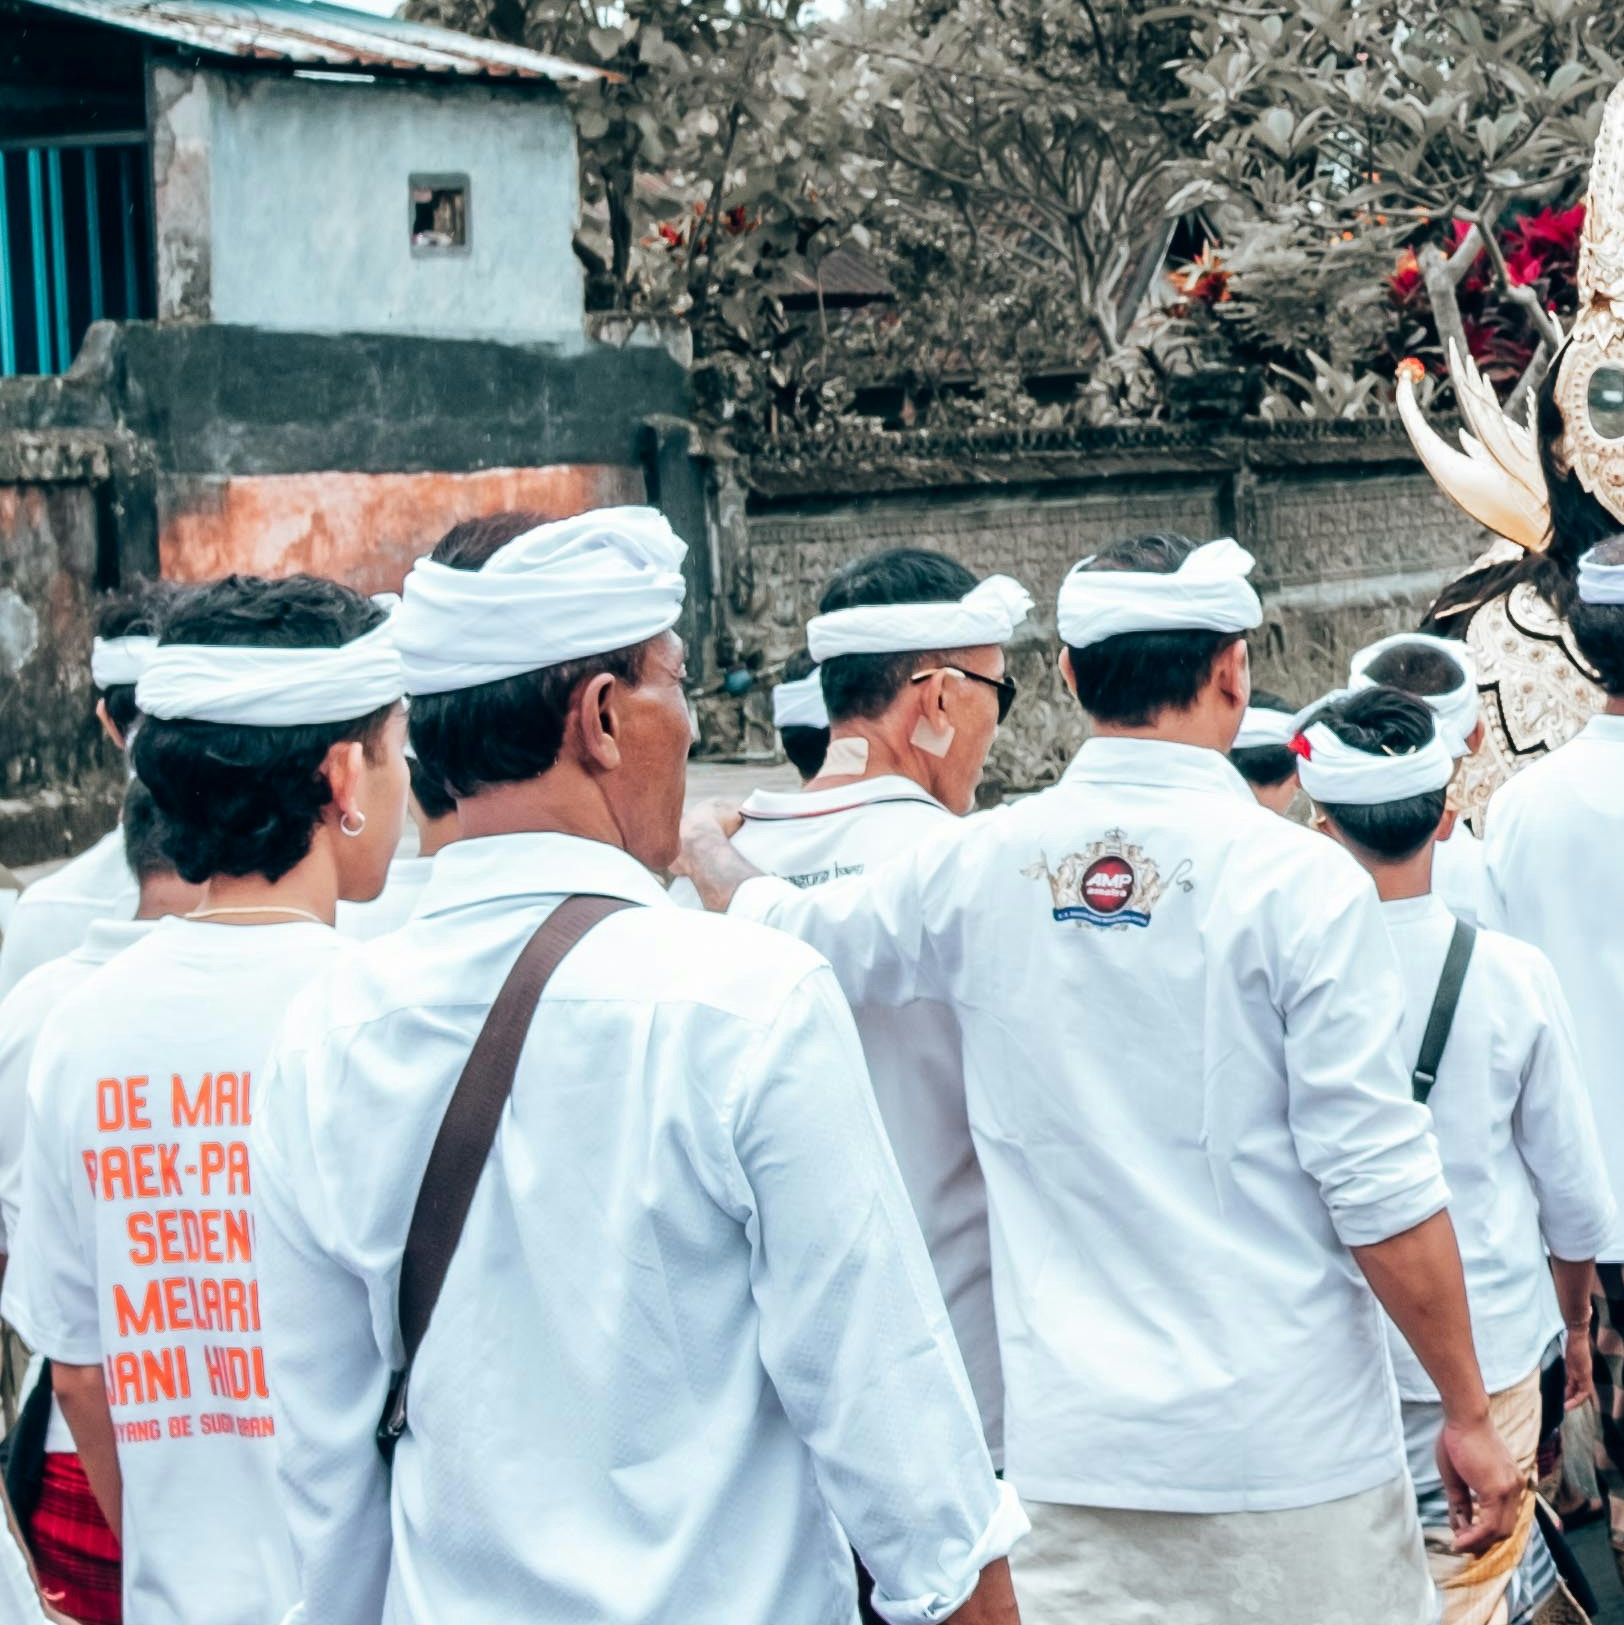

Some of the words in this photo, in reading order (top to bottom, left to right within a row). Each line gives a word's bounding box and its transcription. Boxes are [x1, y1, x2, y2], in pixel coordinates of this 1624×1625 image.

[1085, 872, 1133, 889] AMP
[97, 1075, 152, 1132] DE
[126, 1209, 256, 1265] SEDEN
